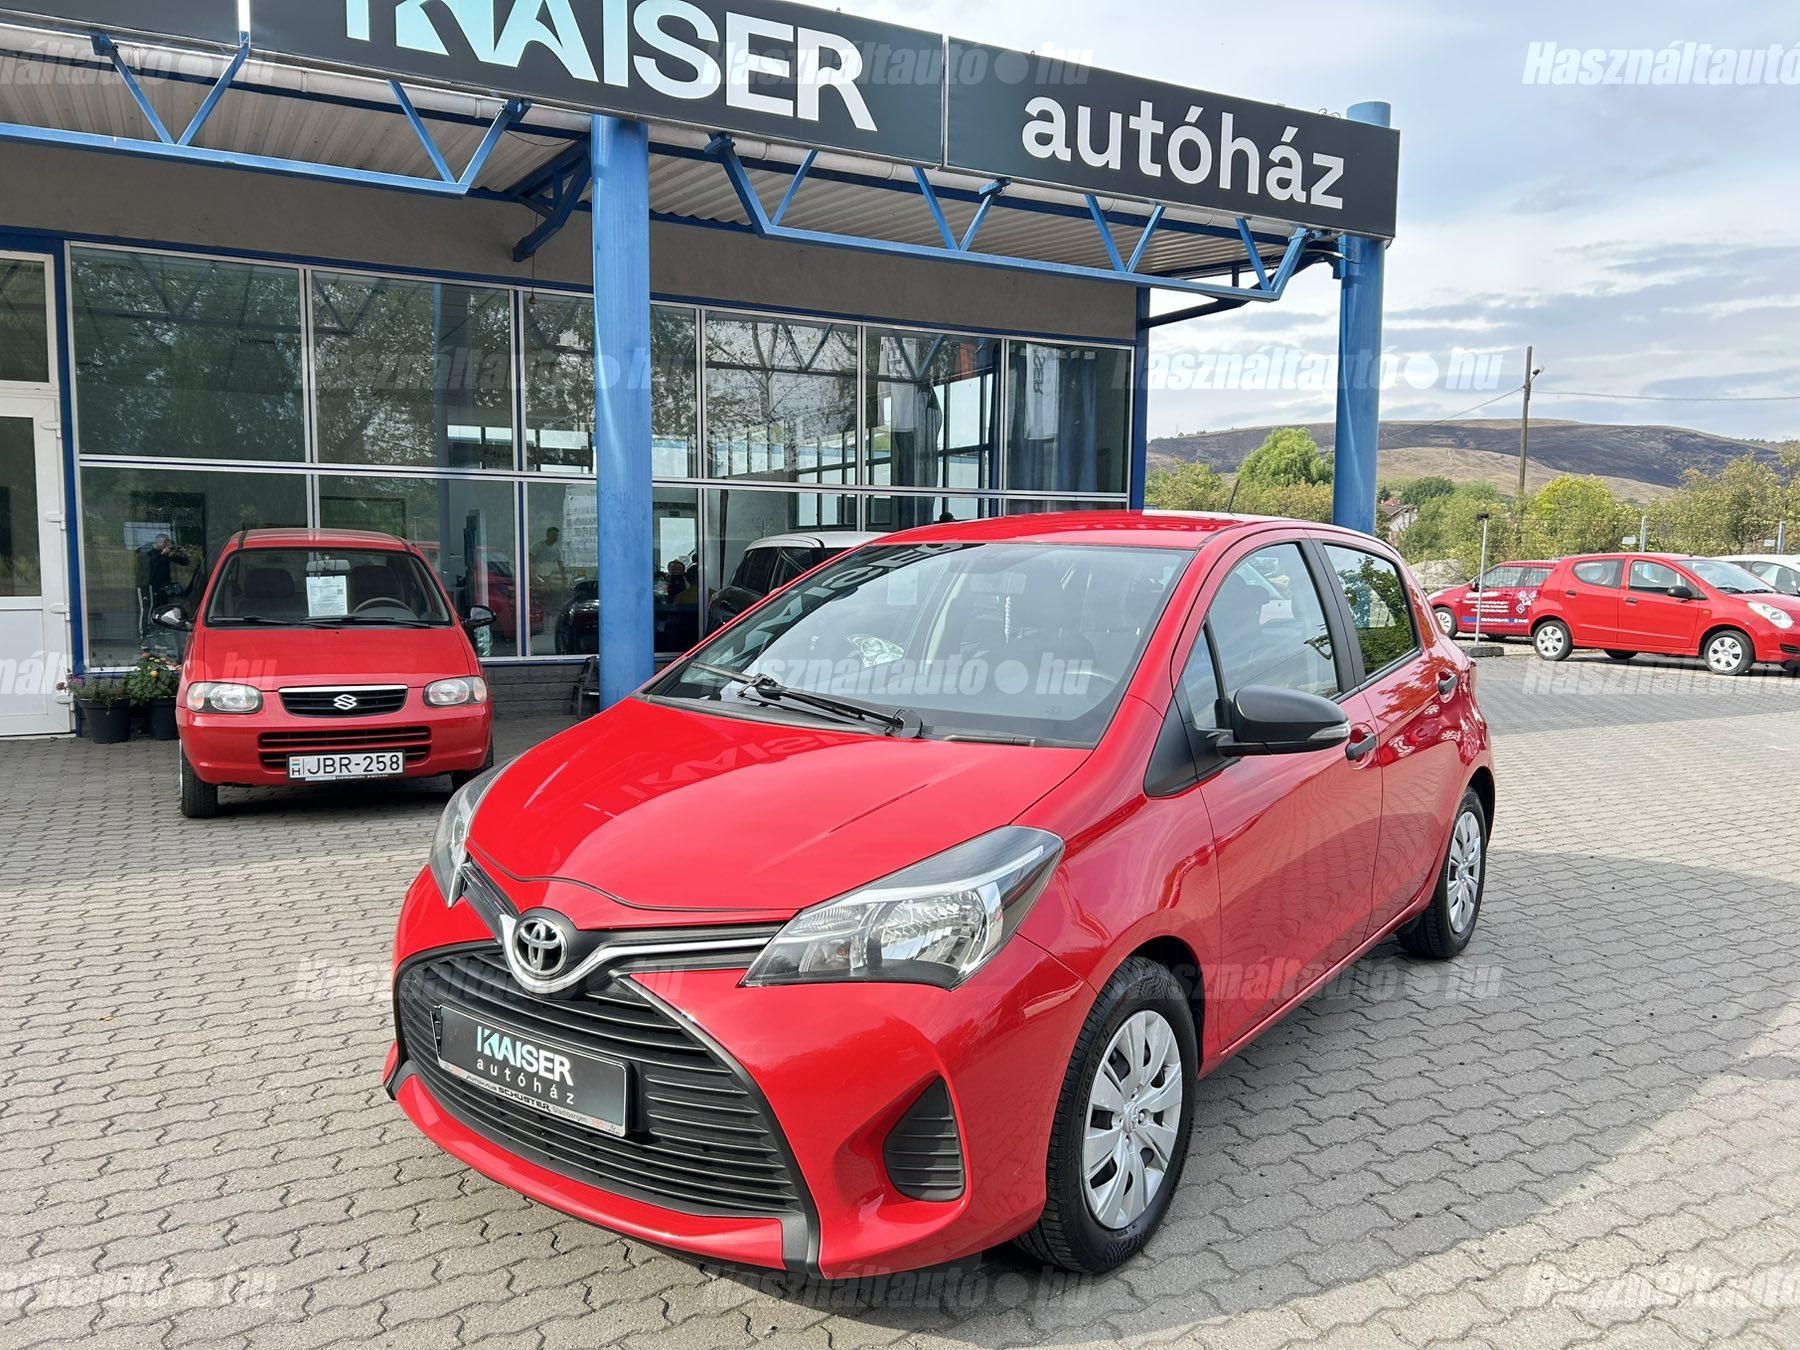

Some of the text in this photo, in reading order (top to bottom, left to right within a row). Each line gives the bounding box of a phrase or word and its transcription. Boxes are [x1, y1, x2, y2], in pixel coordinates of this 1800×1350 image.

[1022, 96, 1344, 210] autóház
[307, 754, 400, 775] JBR-258
[477, 1026, 574, 1086] KAISER
[498, 1086, 550, 1112] SCHUSTER
